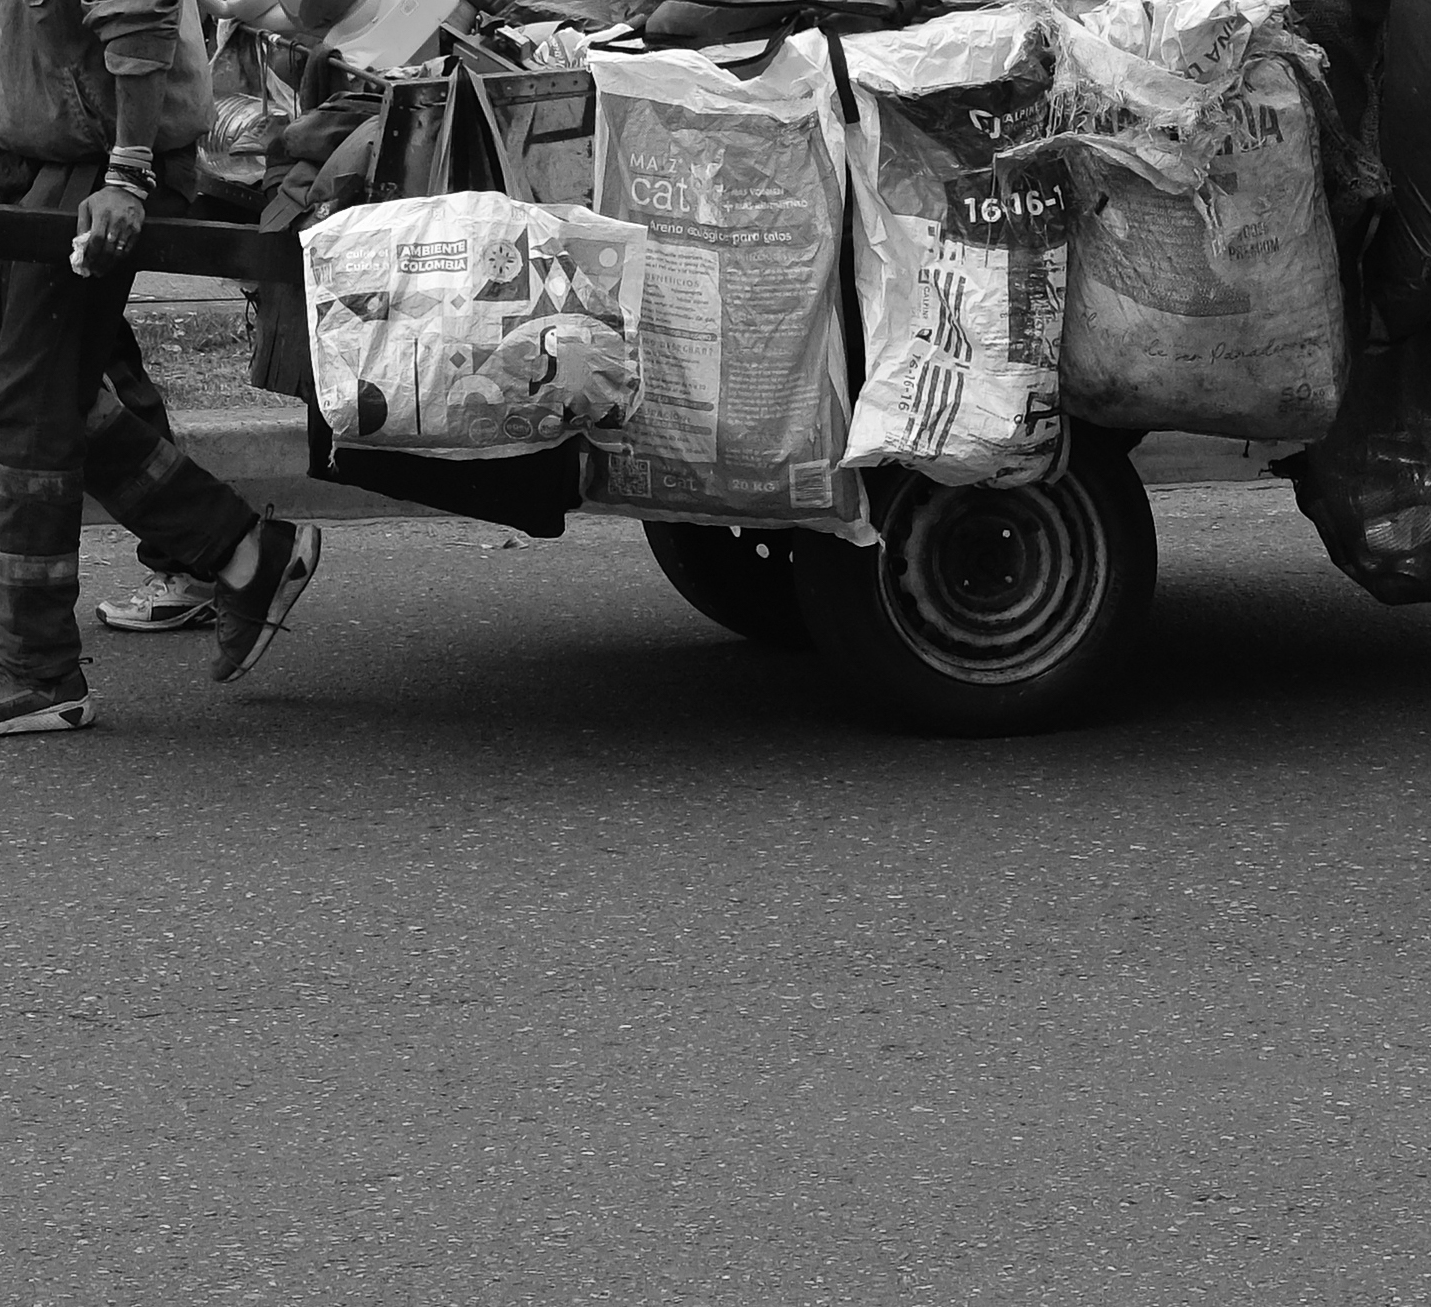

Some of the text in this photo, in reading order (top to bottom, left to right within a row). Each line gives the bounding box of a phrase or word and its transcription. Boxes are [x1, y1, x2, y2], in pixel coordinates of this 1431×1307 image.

[631, 177, 690, 213] cat
[400, 240, 466, 257] AMBIENTE
[400, 259, 466, 272] COLOMBIA
